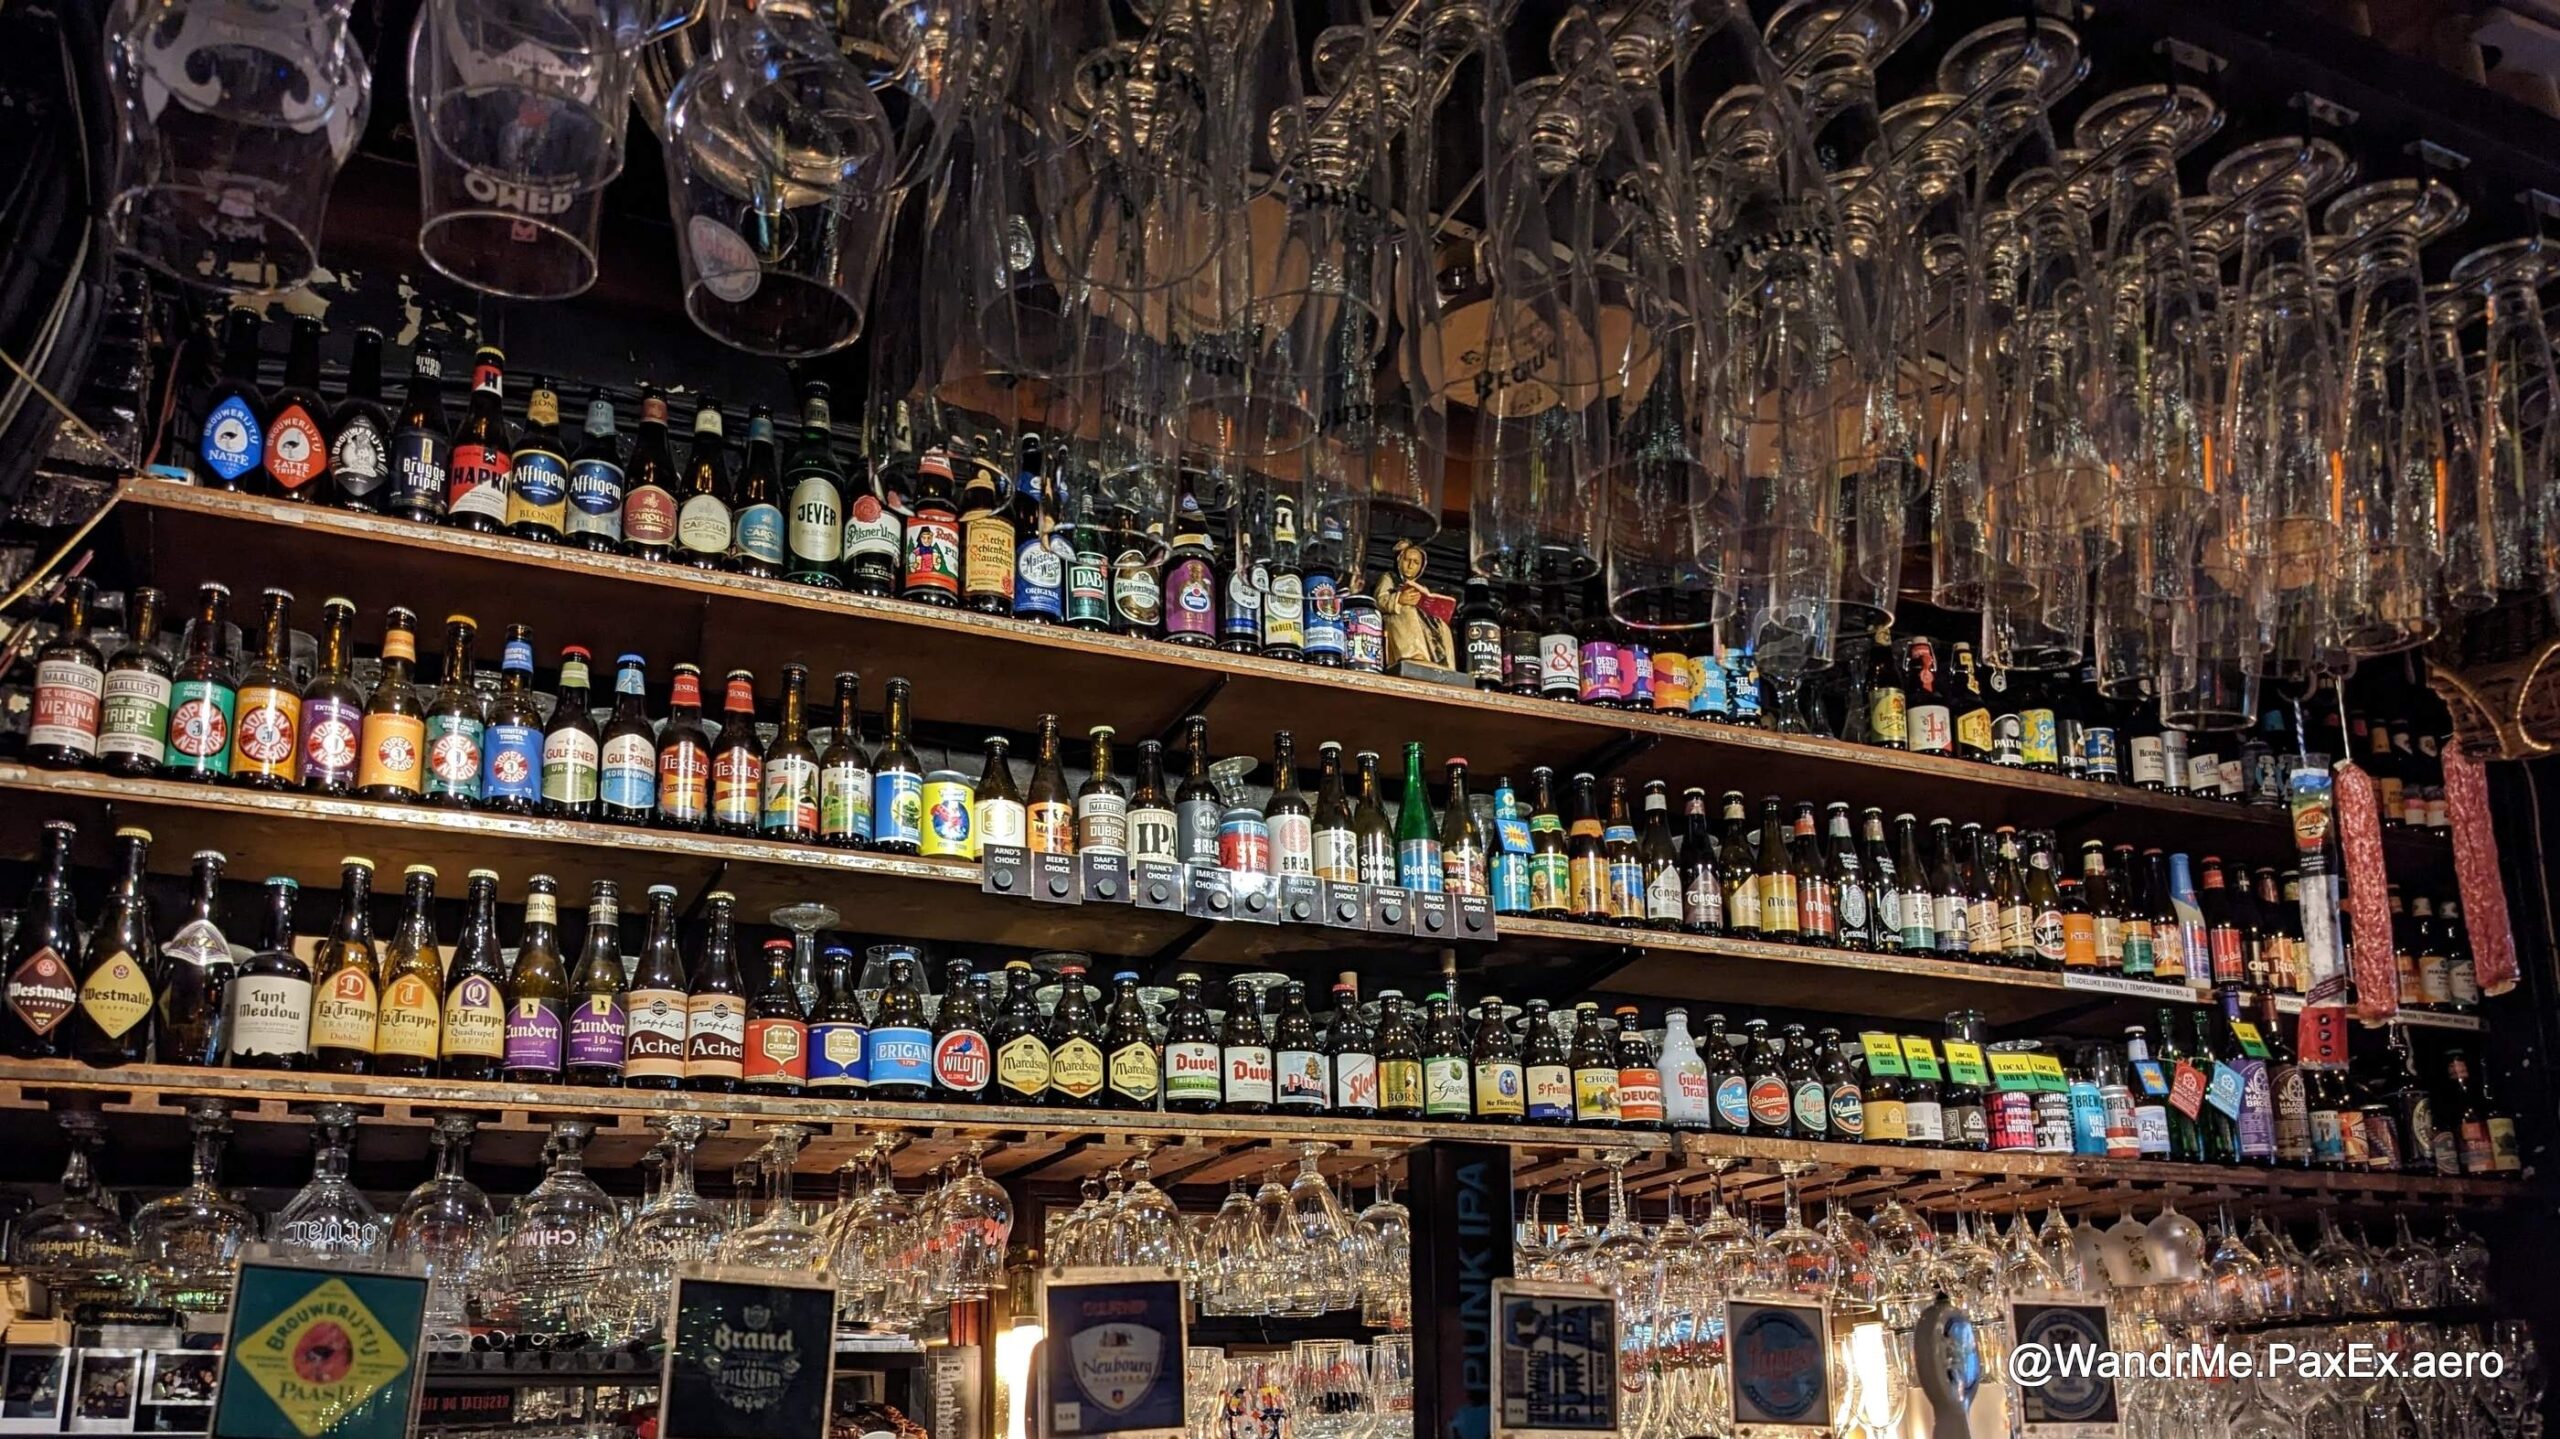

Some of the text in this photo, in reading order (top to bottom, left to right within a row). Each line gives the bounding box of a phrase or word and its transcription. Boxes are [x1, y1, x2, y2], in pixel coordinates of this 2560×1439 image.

[209, 449, 249, 467] NATTE
[273, 459, 311, 474] ZATTE
[276, 467, 307, 479] TRIPEL
[403, 457, 445, 482] Brugge
[408, 476, 441, 493] Tripel
[453, 466, 507, 494] HAPKI
[512, 466, 566, 491] Affligem
[570, 473, 622, 499] Affligem
[519, 509, 558, 524] BLOND
[627, 513, 673, 528] CAROLUS
[797, 503, 837, 527] JEVER
[847, 523, 879, 550] Pilsner
[1076, 567, 1103, 588] DAB
[1271, 621, 1293, 634] RADLER
[1736, 677, 1749, 688] ZEE
[40, 700, 94, 724] VIENNA
[104, 708, 155, 728] TRIPEL
[340, 708, 359, 721] STOUT
[53, 714, 80, 728] BIER
[113, 722, 138, 733] BIER
[497, 728, 528, 736] TRINITAS
[500, 734, 524, 742] TRIPEL
[379, 737, 413, 752] JOPEN
[1994, 739, 2015, 749] PAIX
[382, 755, 416, 772] JOPEN
[495, 750, 525, 766] JOPEN
[607, 751, 655, 770] GULPENER
[661, 753, 709, 778] TEXELS
[497, 767, 528, 784] JOPEN
[713, 760, 761, 781] TEXELS
[1090, 825, 1125, 841] DUBBEL
[1137, 822, 1177, 857] IPA
[1102, 837, 1119, 847] BIER
[994, 846, 1022, 858] ARND'S
[994, 855, 1021, 866] CHOICE
[1045, 855, 1070, 865] BEER'S
[1093, 863, 1119, 872] CHOICE
[1044, 864, 1071, 874] CHOICE
[1145, 863, 1173, 873] FRANK'S
[1196, 869, 1222, 881] IMRE'S
[1147, 872, 1171, 881] CHOICE
[1290, 886, 1313, 895] CHOICE
[1333, 883, 1359, 893] NANCY'S
[1334, 890, 1358, 901] CHOICE
[1376, 888, 1406, 899] PATRICK'S
[1380, 896, 1402, 906] CHOICE
[1424, 894, 1445, 904] PAUL'S
[1424, 902, 1446, 911] CHOICE
[1461, 896, 1488, 906] SOPHIE'S
[1464, 903, 1486, 913] CHOICE
[9, 982, 77, 1003] Westmalle
[340, 977, 363, 997] D
[400, 980, 419, 1006] T
[466, 980, 487, 1006] Q
[2102, 979, 2124, 991] BIEREN
[2129, 982, 2165, 996] TEMPORARY
[2165, 987, 2184, 998] BEERS
[19, 999, 67, 1010] TRAPPIST
[84, 987, 151, 1007] Westmalle
[251, 989, 287, 1007] Tynt
[239, 1002, 301, 1021] Meadow
[318, 1000, 376, 1023] La Trappe
[379, 1008, 437, 1029] La Trappe
[446, 1008, 503, 1028] La Trappe
[322, 1019, 370, 1032] TRAPPIST
[571, 1018, 626, 1037] Zundert
[632, 1013, 685, 1032] Trappist
[692, 1015, 744, 1033] Trappist
[330, 1031, 361, 1044] Dubbel
[393, 1027, 418, 1039] Tripel
[450, 1027, 495, 1040] Quadrupel
[505, 1022, 559, 1042] Zundert
[381, 1036, 428, 1049] TRAPPIST
[449, 1036, 495, 1047] TRAPPIST
[594, 1035, 608, 1046] 10
[630, 1036, 684, 1056] Achel
[767, 1041, 798, 1052] CHIMAY
[584, 1046, 613, 1054] TRAPPIST
[691, 1039, 744, 1059] Achel
[829, 1046, 859, 1056] CHIMAY
[1911, 1047, 1928, 1055] LOCAL
[1955, 1052, 1974, 1060] LOCAL
[1175, 1052, 1218, 1073] Duvel
[1999, 1063, 2026, 1071] LOCAL
[2034, 1063, 2057, 1073] LOCAL
[969, 1061, 986, 1085] JO
[1960, 1067, 1976, 1075] BEER
[2003, 1074, 2029, 1082] BREW
[1457, 1159, 1491, 1394] PUNK IPA
[714, 1321, 795, 1351] Brand
[1082, 1358, 1153, 1380] Neubourg
[721, 1368, 782, 1389] PILSENER
